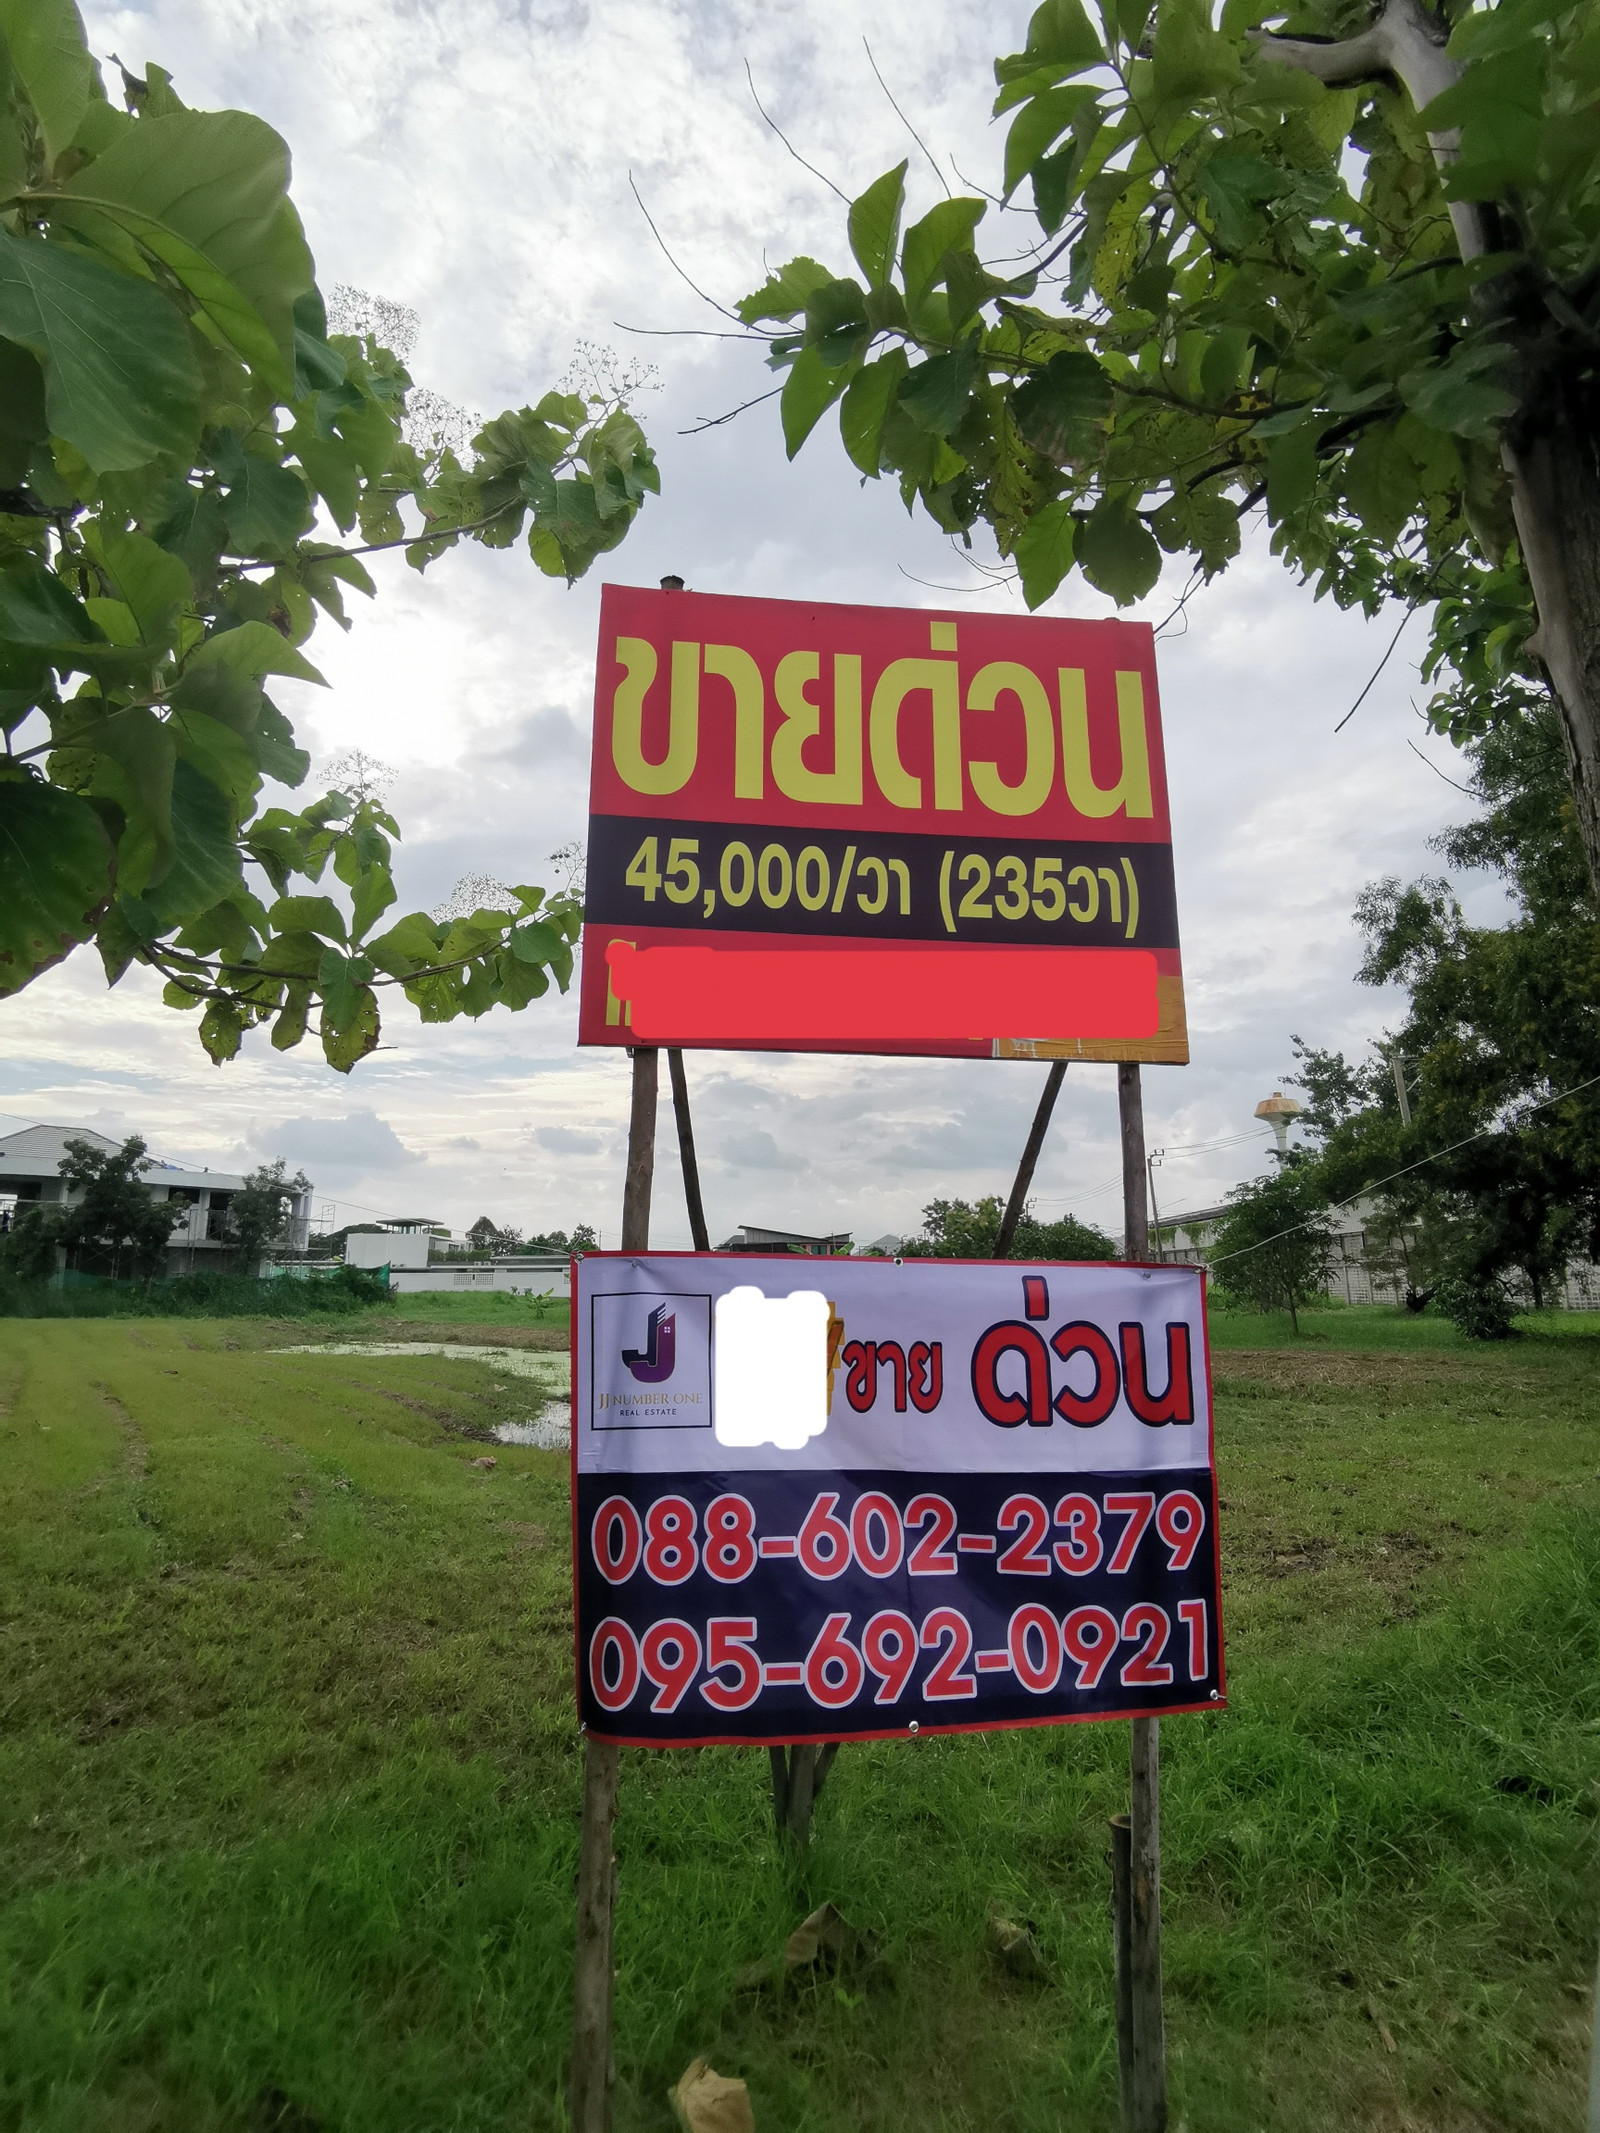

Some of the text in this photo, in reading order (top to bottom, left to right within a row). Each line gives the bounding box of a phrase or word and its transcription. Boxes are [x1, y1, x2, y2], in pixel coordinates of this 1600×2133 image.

[612, 621, 1153, 818] ขายด่วน
[625, 836, 1140, 938] 45,000/วา (235วา)
[598, 1392, 703, 1410] JJ NUMBER ONE
[843, 1275, 1195, 1428] ขาย ด่วน
[619, 1408, 678, 1417] REAL ESTATE
[591, 1490, 1205, 1586] 088-602-2379
[589, 1599, 1207, 1713] 095-692-0921
